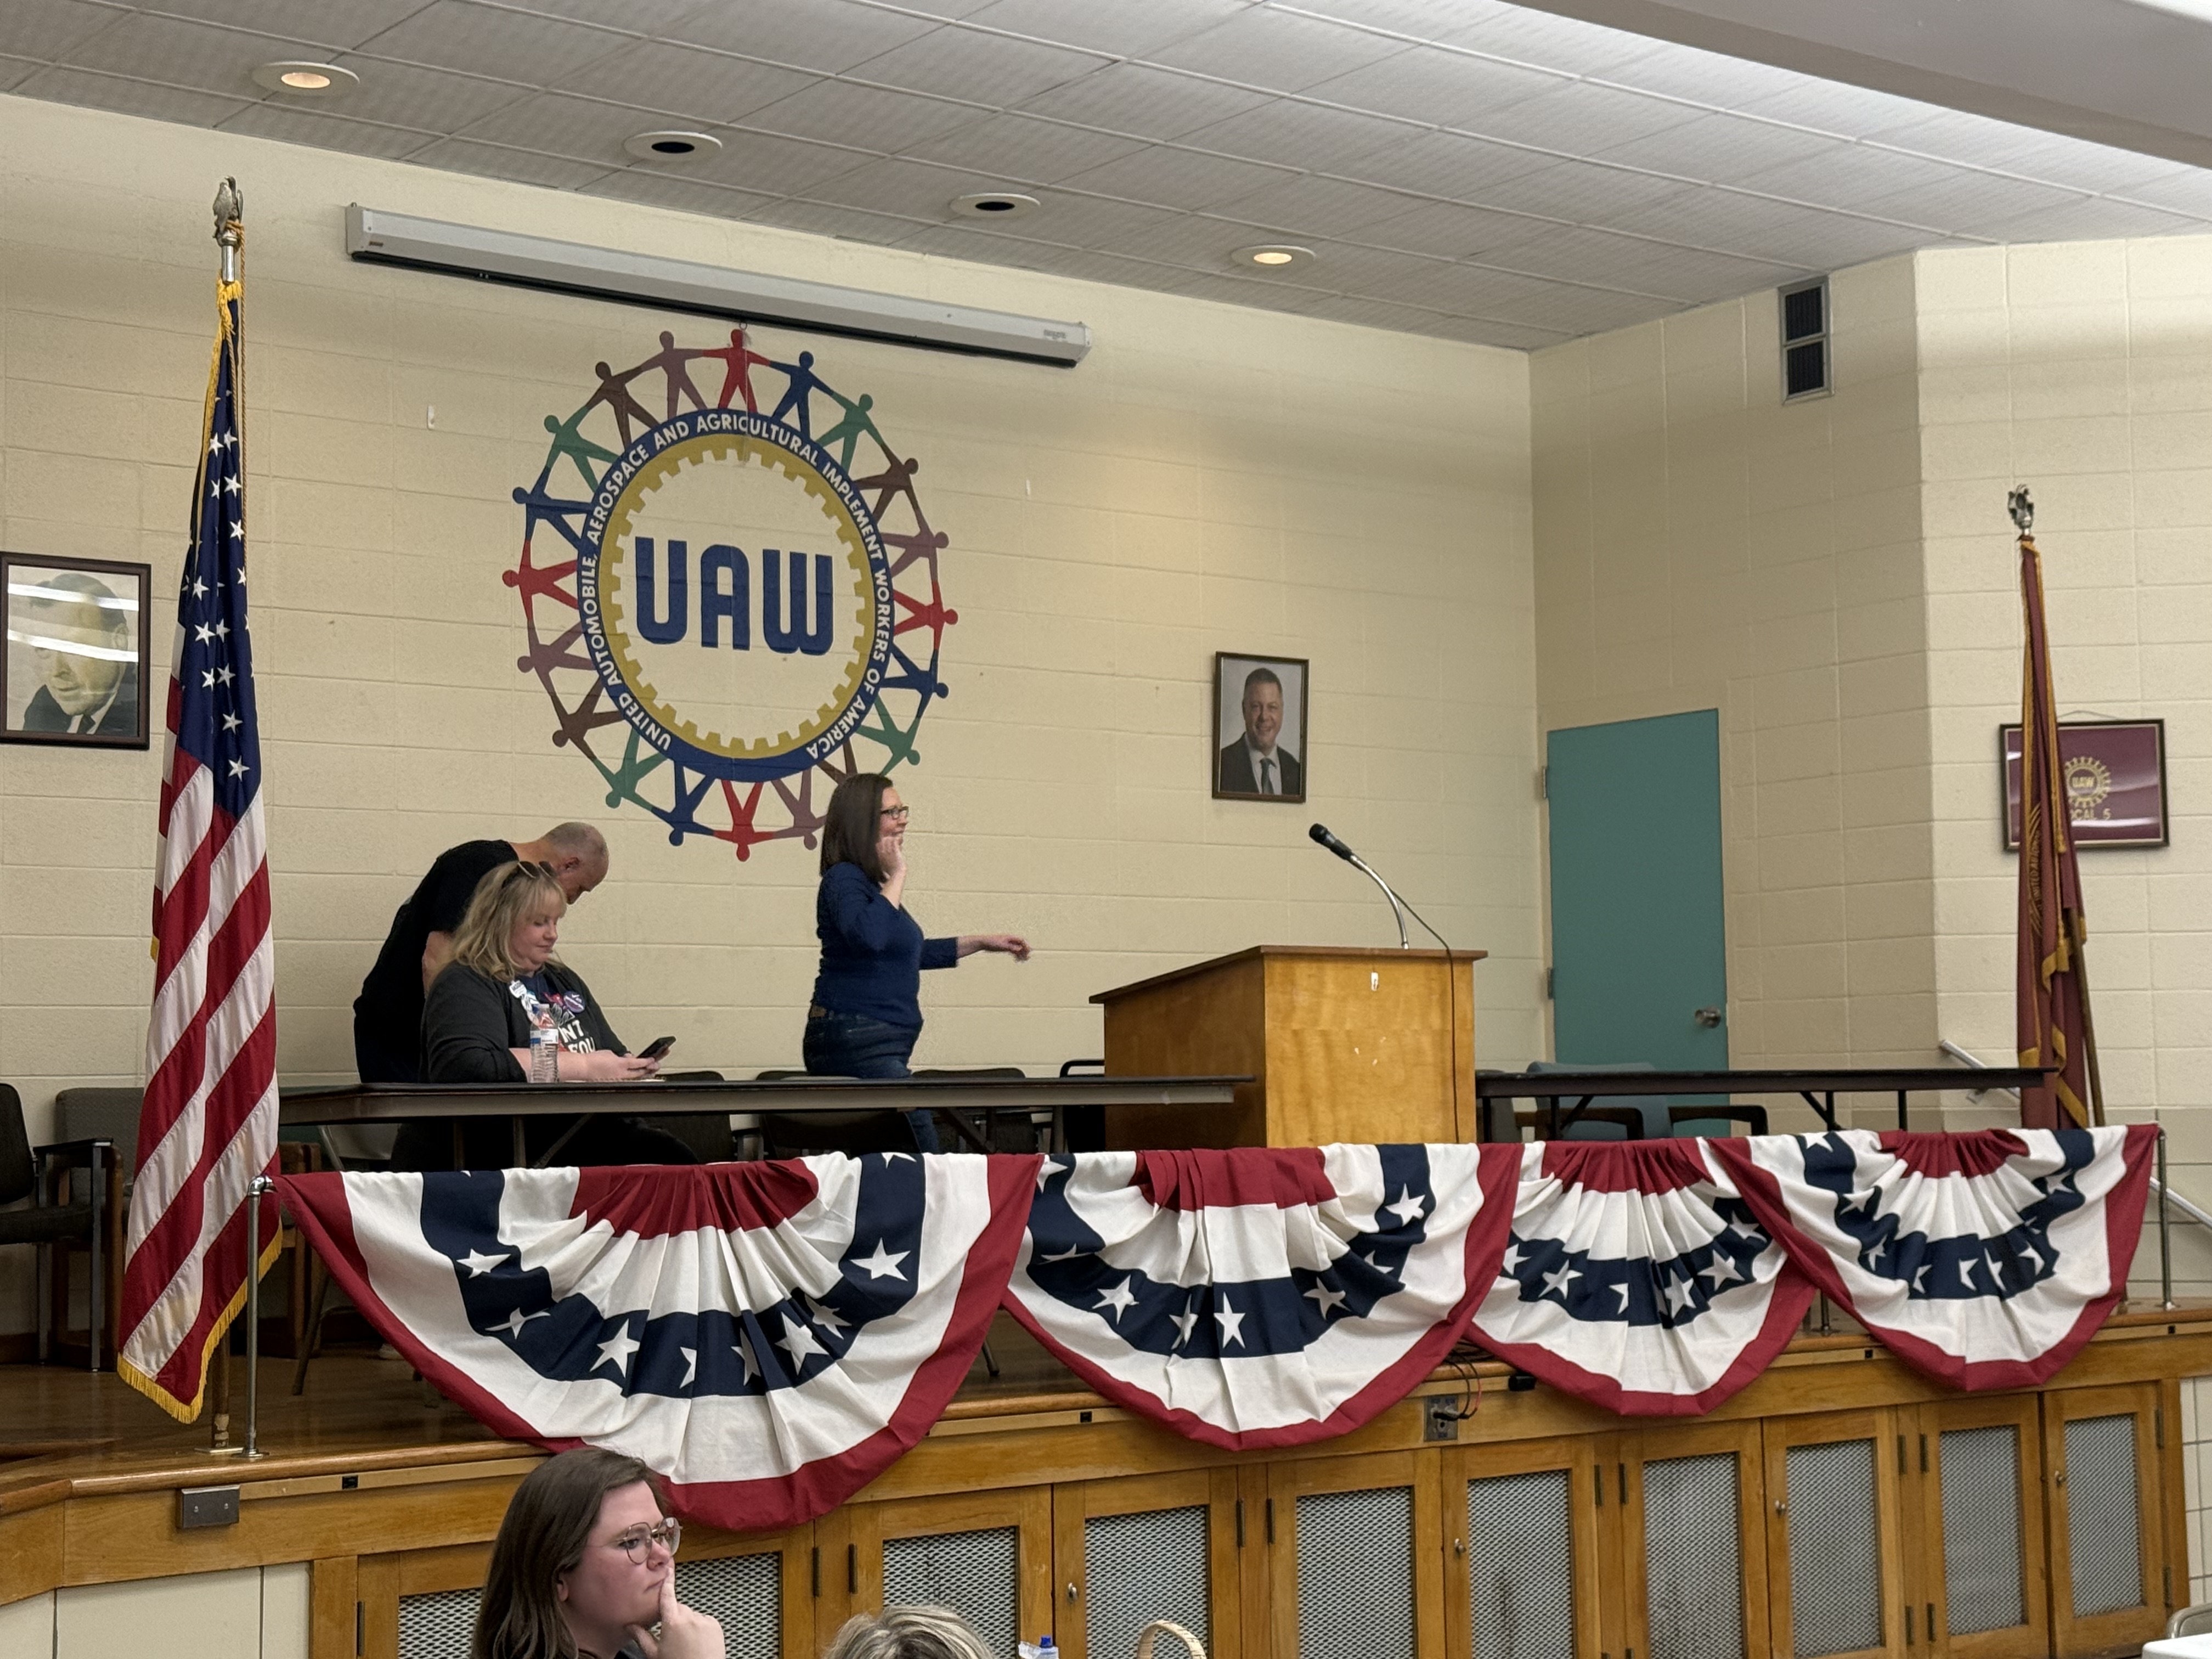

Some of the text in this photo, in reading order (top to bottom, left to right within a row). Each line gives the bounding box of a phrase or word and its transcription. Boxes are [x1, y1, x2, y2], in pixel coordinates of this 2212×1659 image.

[582, 414, 891, 760] UNITED AUTOMOBILE, AEROSPACE AND AGRICULTURAL IMPLEMENT WORKERS OF AMERICA
[635, 536, 834, 656] UAW
[2072, 776, 2095, 788] UAW
